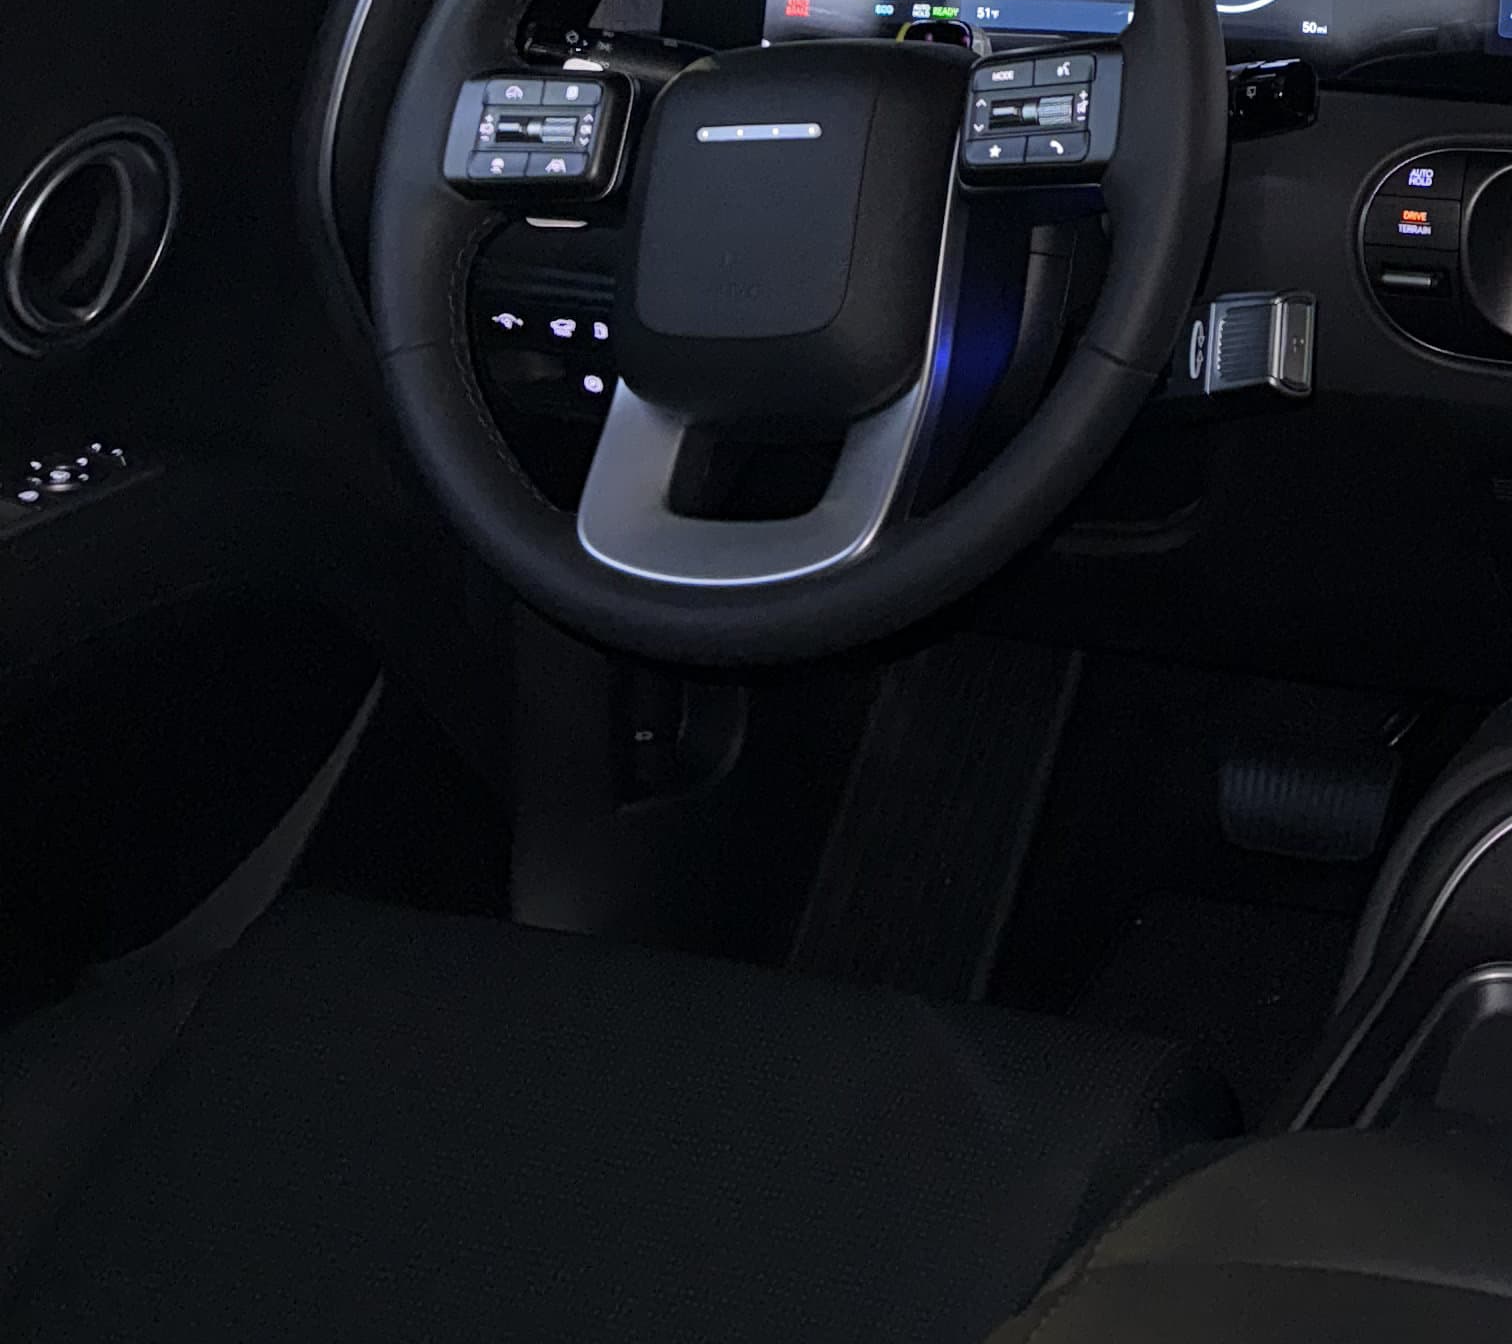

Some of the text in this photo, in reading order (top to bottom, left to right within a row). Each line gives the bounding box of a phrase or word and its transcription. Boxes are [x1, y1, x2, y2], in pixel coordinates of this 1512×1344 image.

[932, 6, 960, 18] READY
[992, 70, 1014, 81] MODE
[1409, 168, 1434, 178] AUTO
[1408, 176, 1433, 187] HOLD
[1403, 210, 1427, 222] DRIVE
[1398, 223, 1432, 235] TERRAIN
